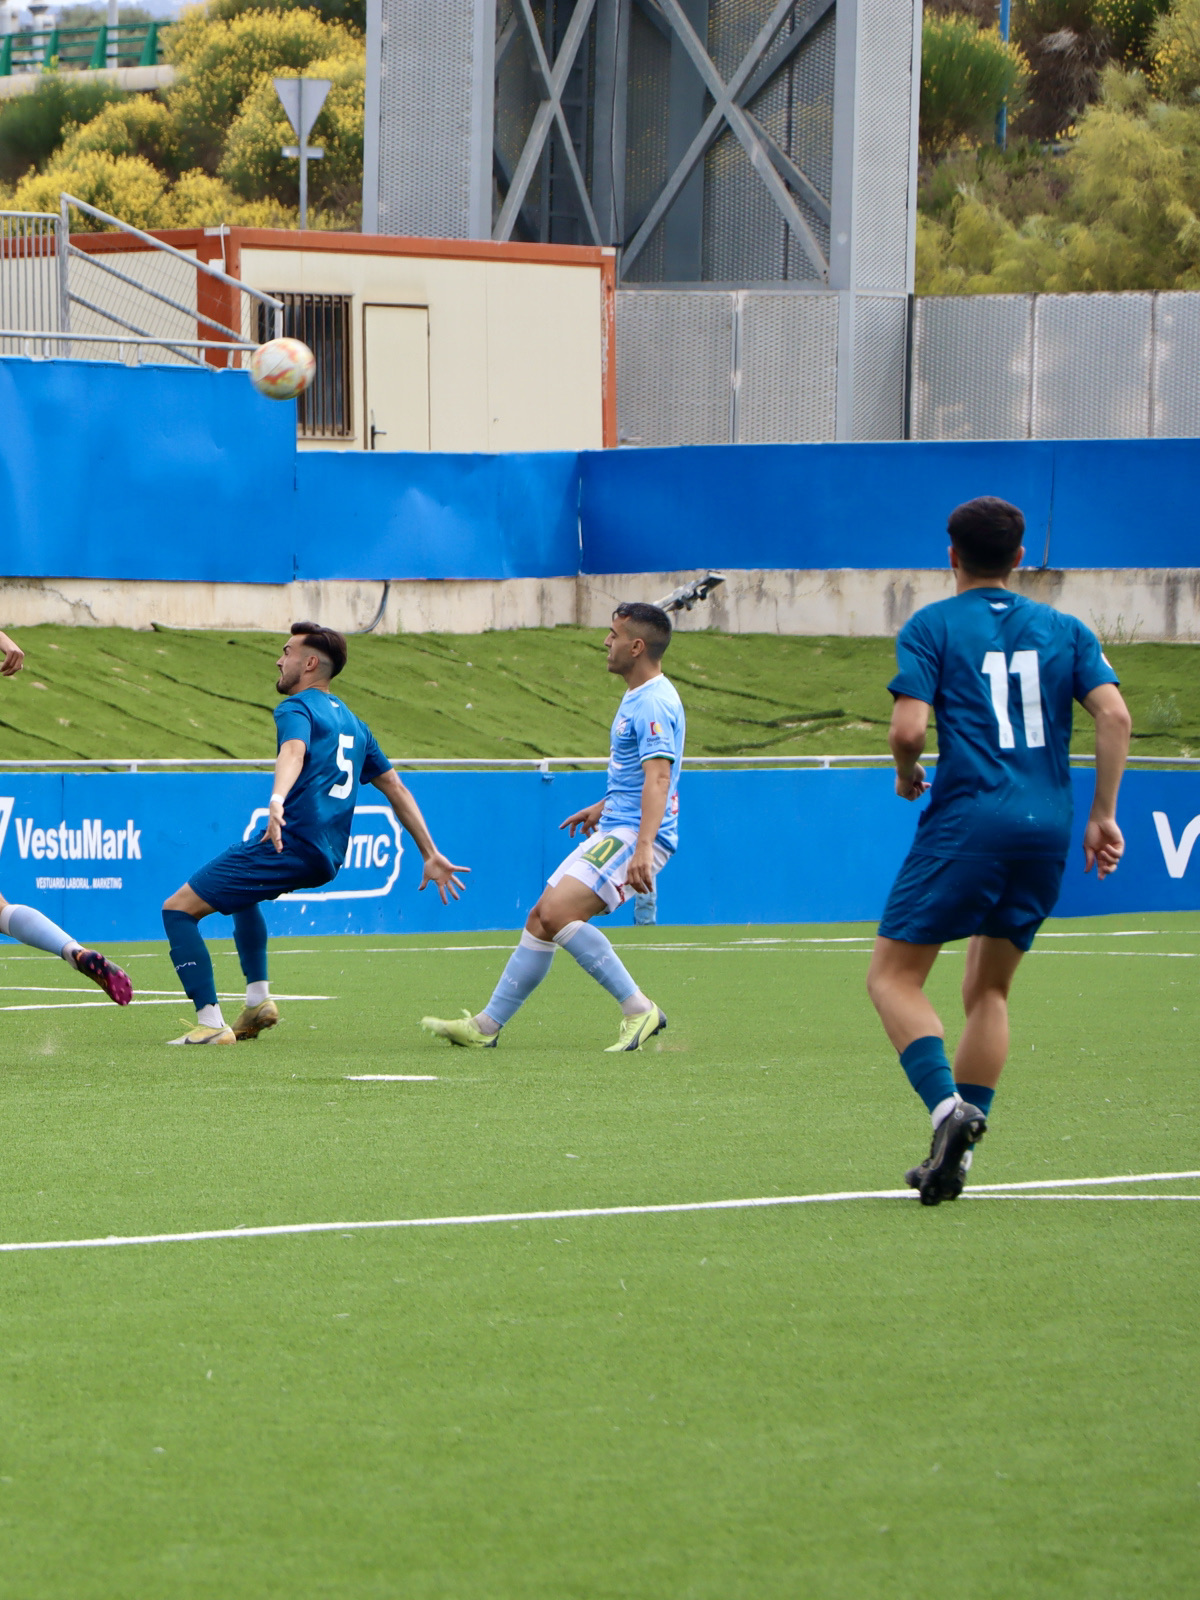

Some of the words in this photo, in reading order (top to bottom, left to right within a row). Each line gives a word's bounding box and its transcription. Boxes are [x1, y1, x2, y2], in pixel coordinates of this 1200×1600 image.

[982, 650, 1045, 749] 11
[328, 733, 354, 799] 5
[15, 818, 142, 860] VestuMark
